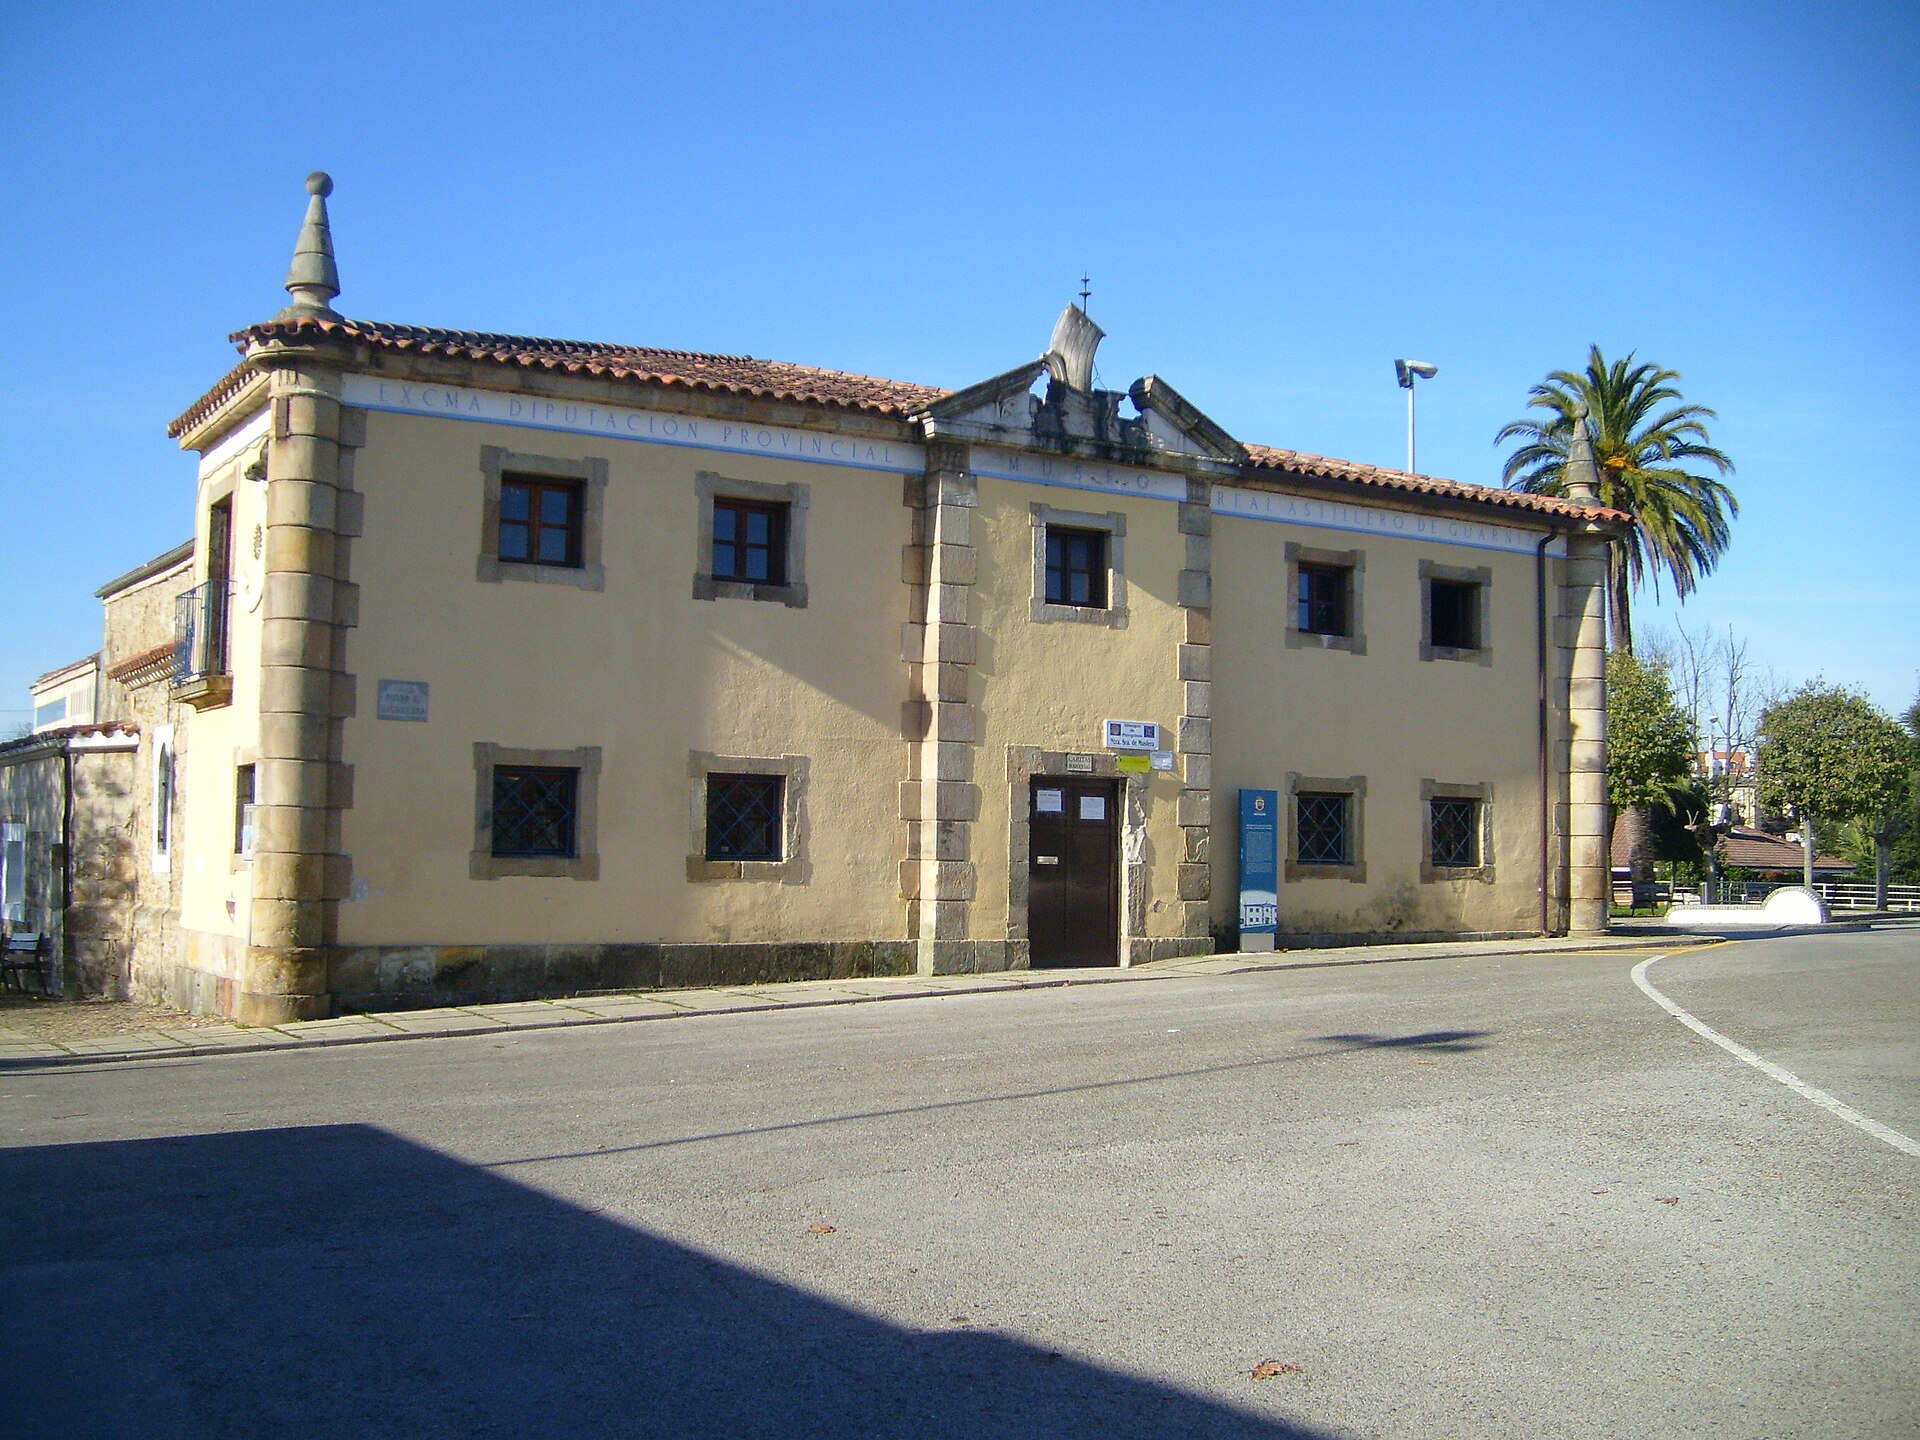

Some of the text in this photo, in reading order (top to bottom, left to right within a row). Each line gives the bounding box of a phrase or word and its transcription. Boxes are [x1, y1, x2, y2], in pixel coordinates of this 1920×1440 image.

[723, 425, 893, 463] PROVINCIAL
[1008, 457, 1150, 489] MUSEO
[1217, 490, 1542, 549] REAL ASTILLERO DE GUARNIZ
